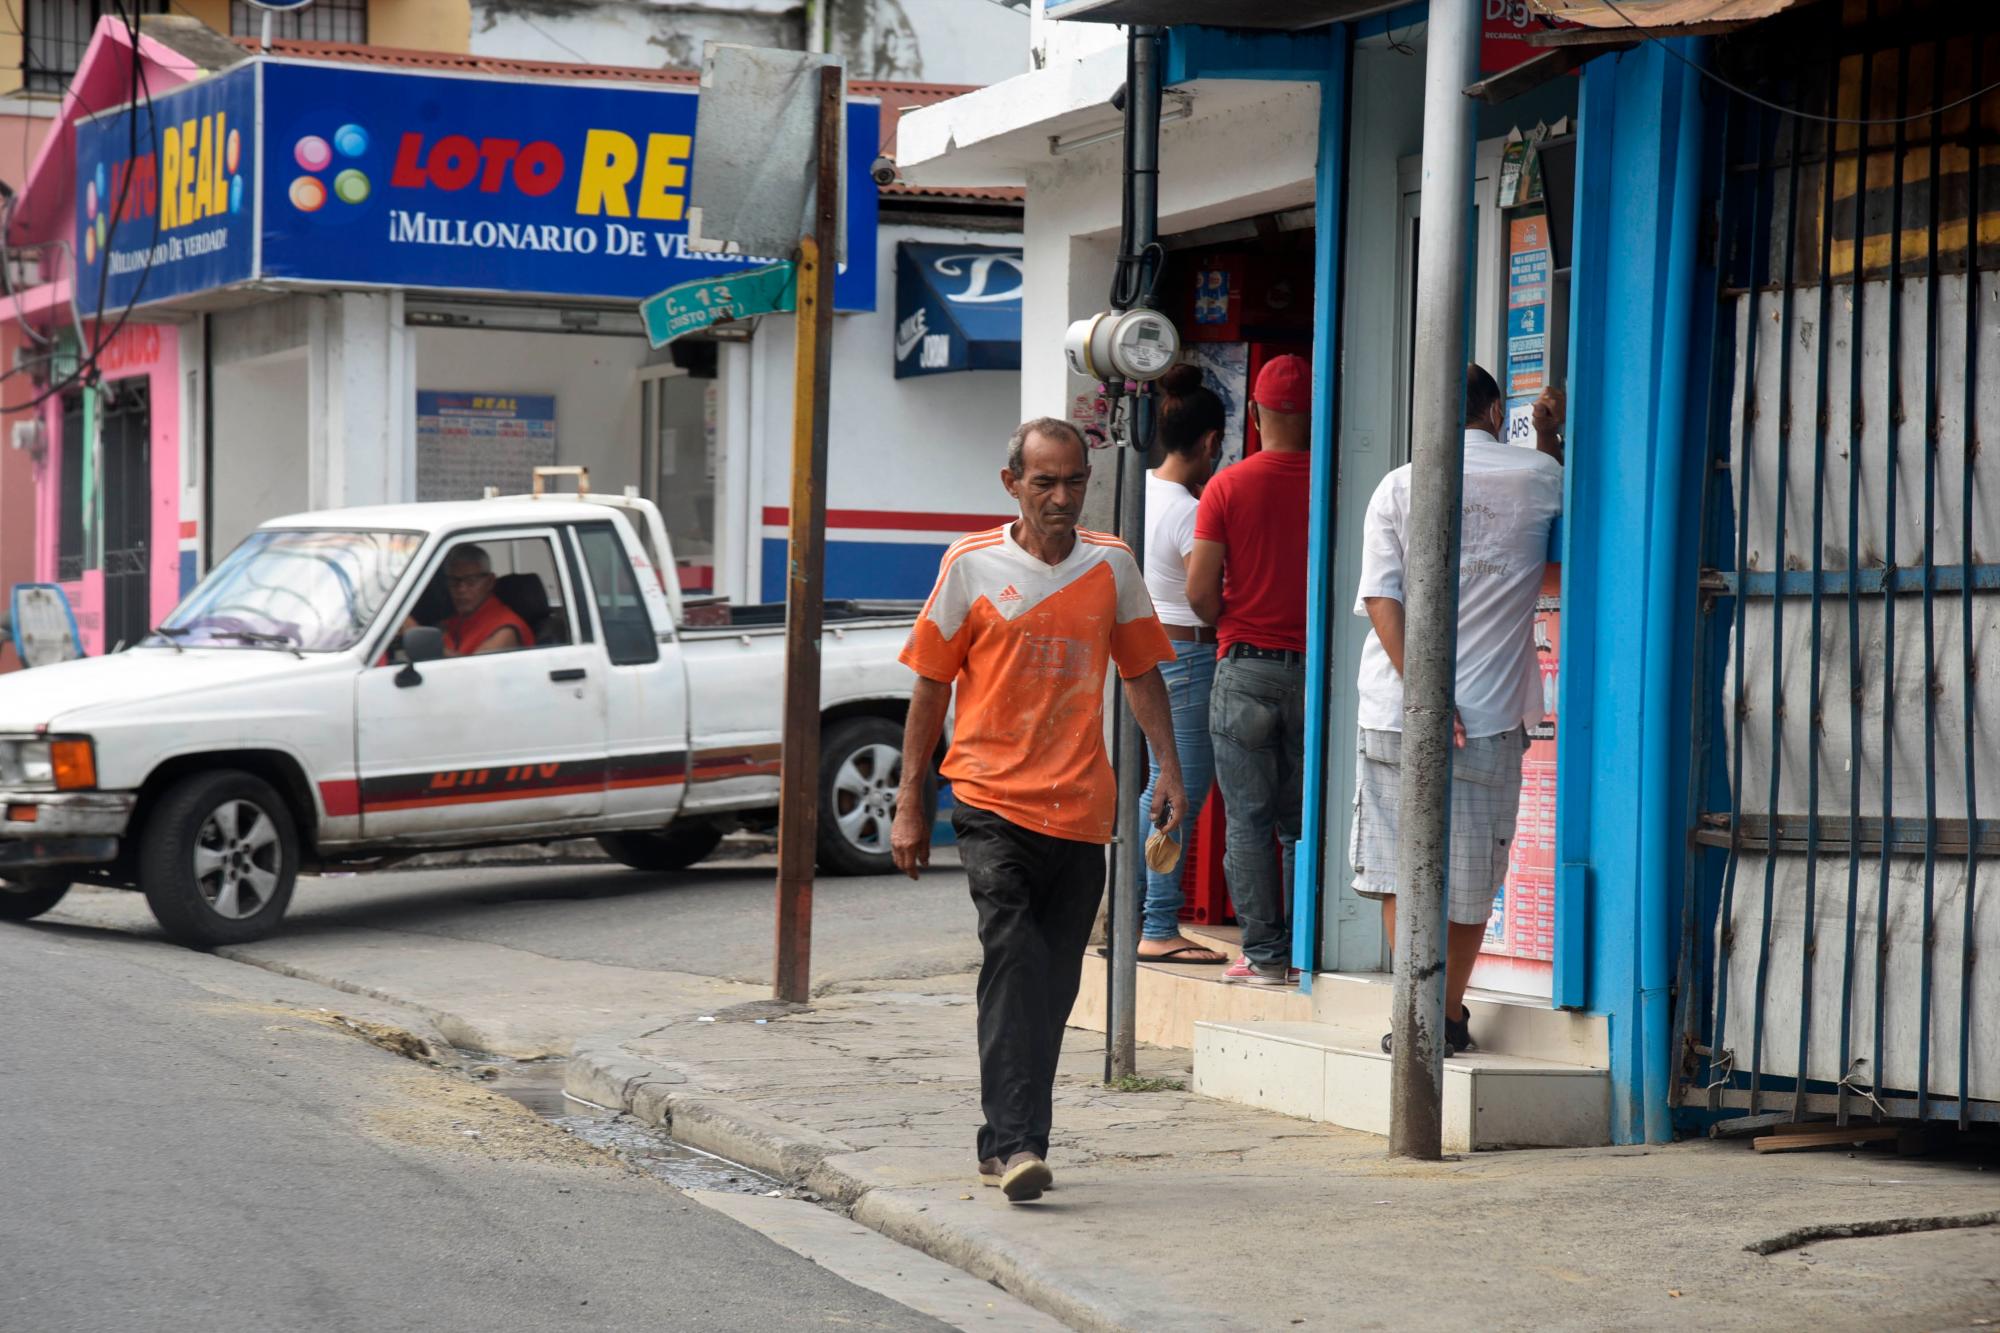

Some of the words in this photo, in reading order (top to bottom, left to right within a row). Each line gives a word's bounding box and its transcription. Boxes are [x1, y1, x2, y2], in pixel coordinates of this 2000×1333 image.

[109, 152, 157, 225] LOTO
[161, 112, 228, 230] REAL
[391, 132, 565, 198] LOTO
[576, 129, 691, 220] RE
[696, 286, 734, 306] 13
[1511, 416, 1529, 439] APS
[1463, 503, 1496, 519] NITED
